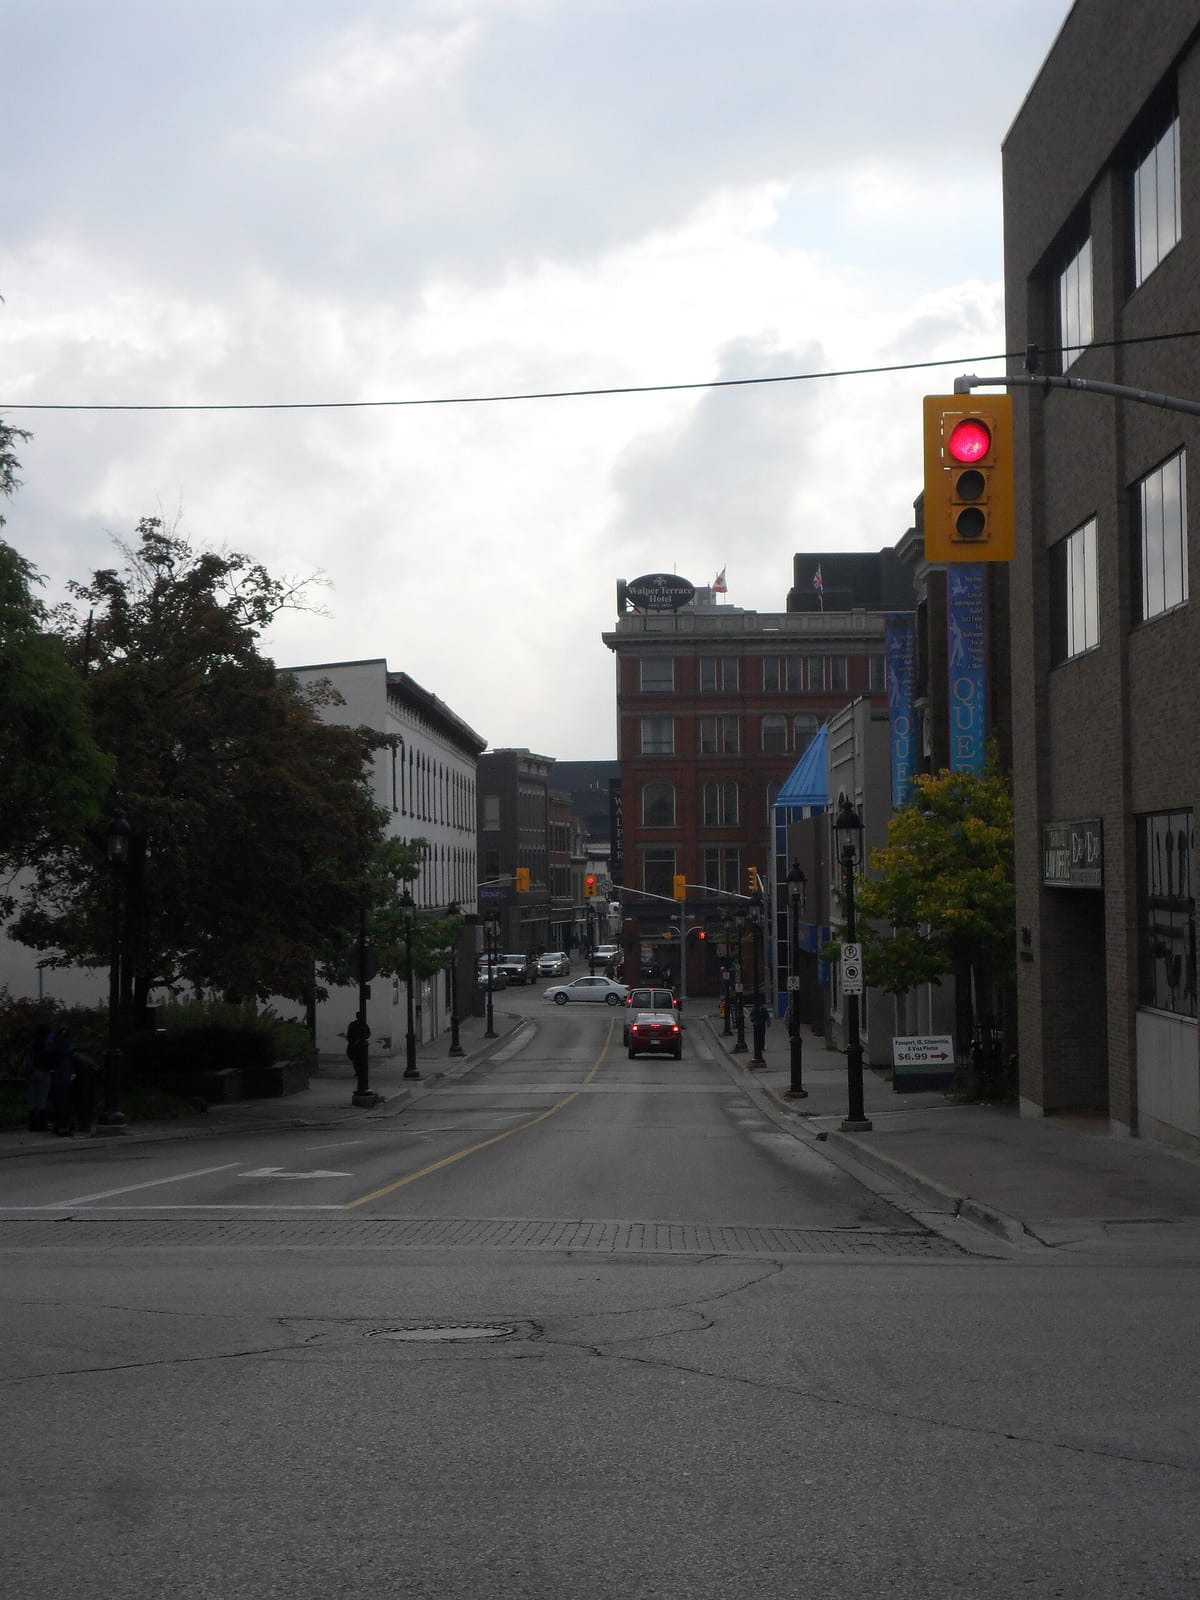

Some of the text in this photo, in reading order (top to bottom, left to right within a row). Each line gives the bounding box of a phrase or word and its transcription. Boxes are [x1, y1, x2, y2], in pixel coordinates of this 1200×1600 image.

[628, 586, 692, 596] Walper Terrace
[649, 595, 672, 603] Hotel
[614, 797, 624, 860] WALPER
[897, 1053, 928, 1061] $6.99
